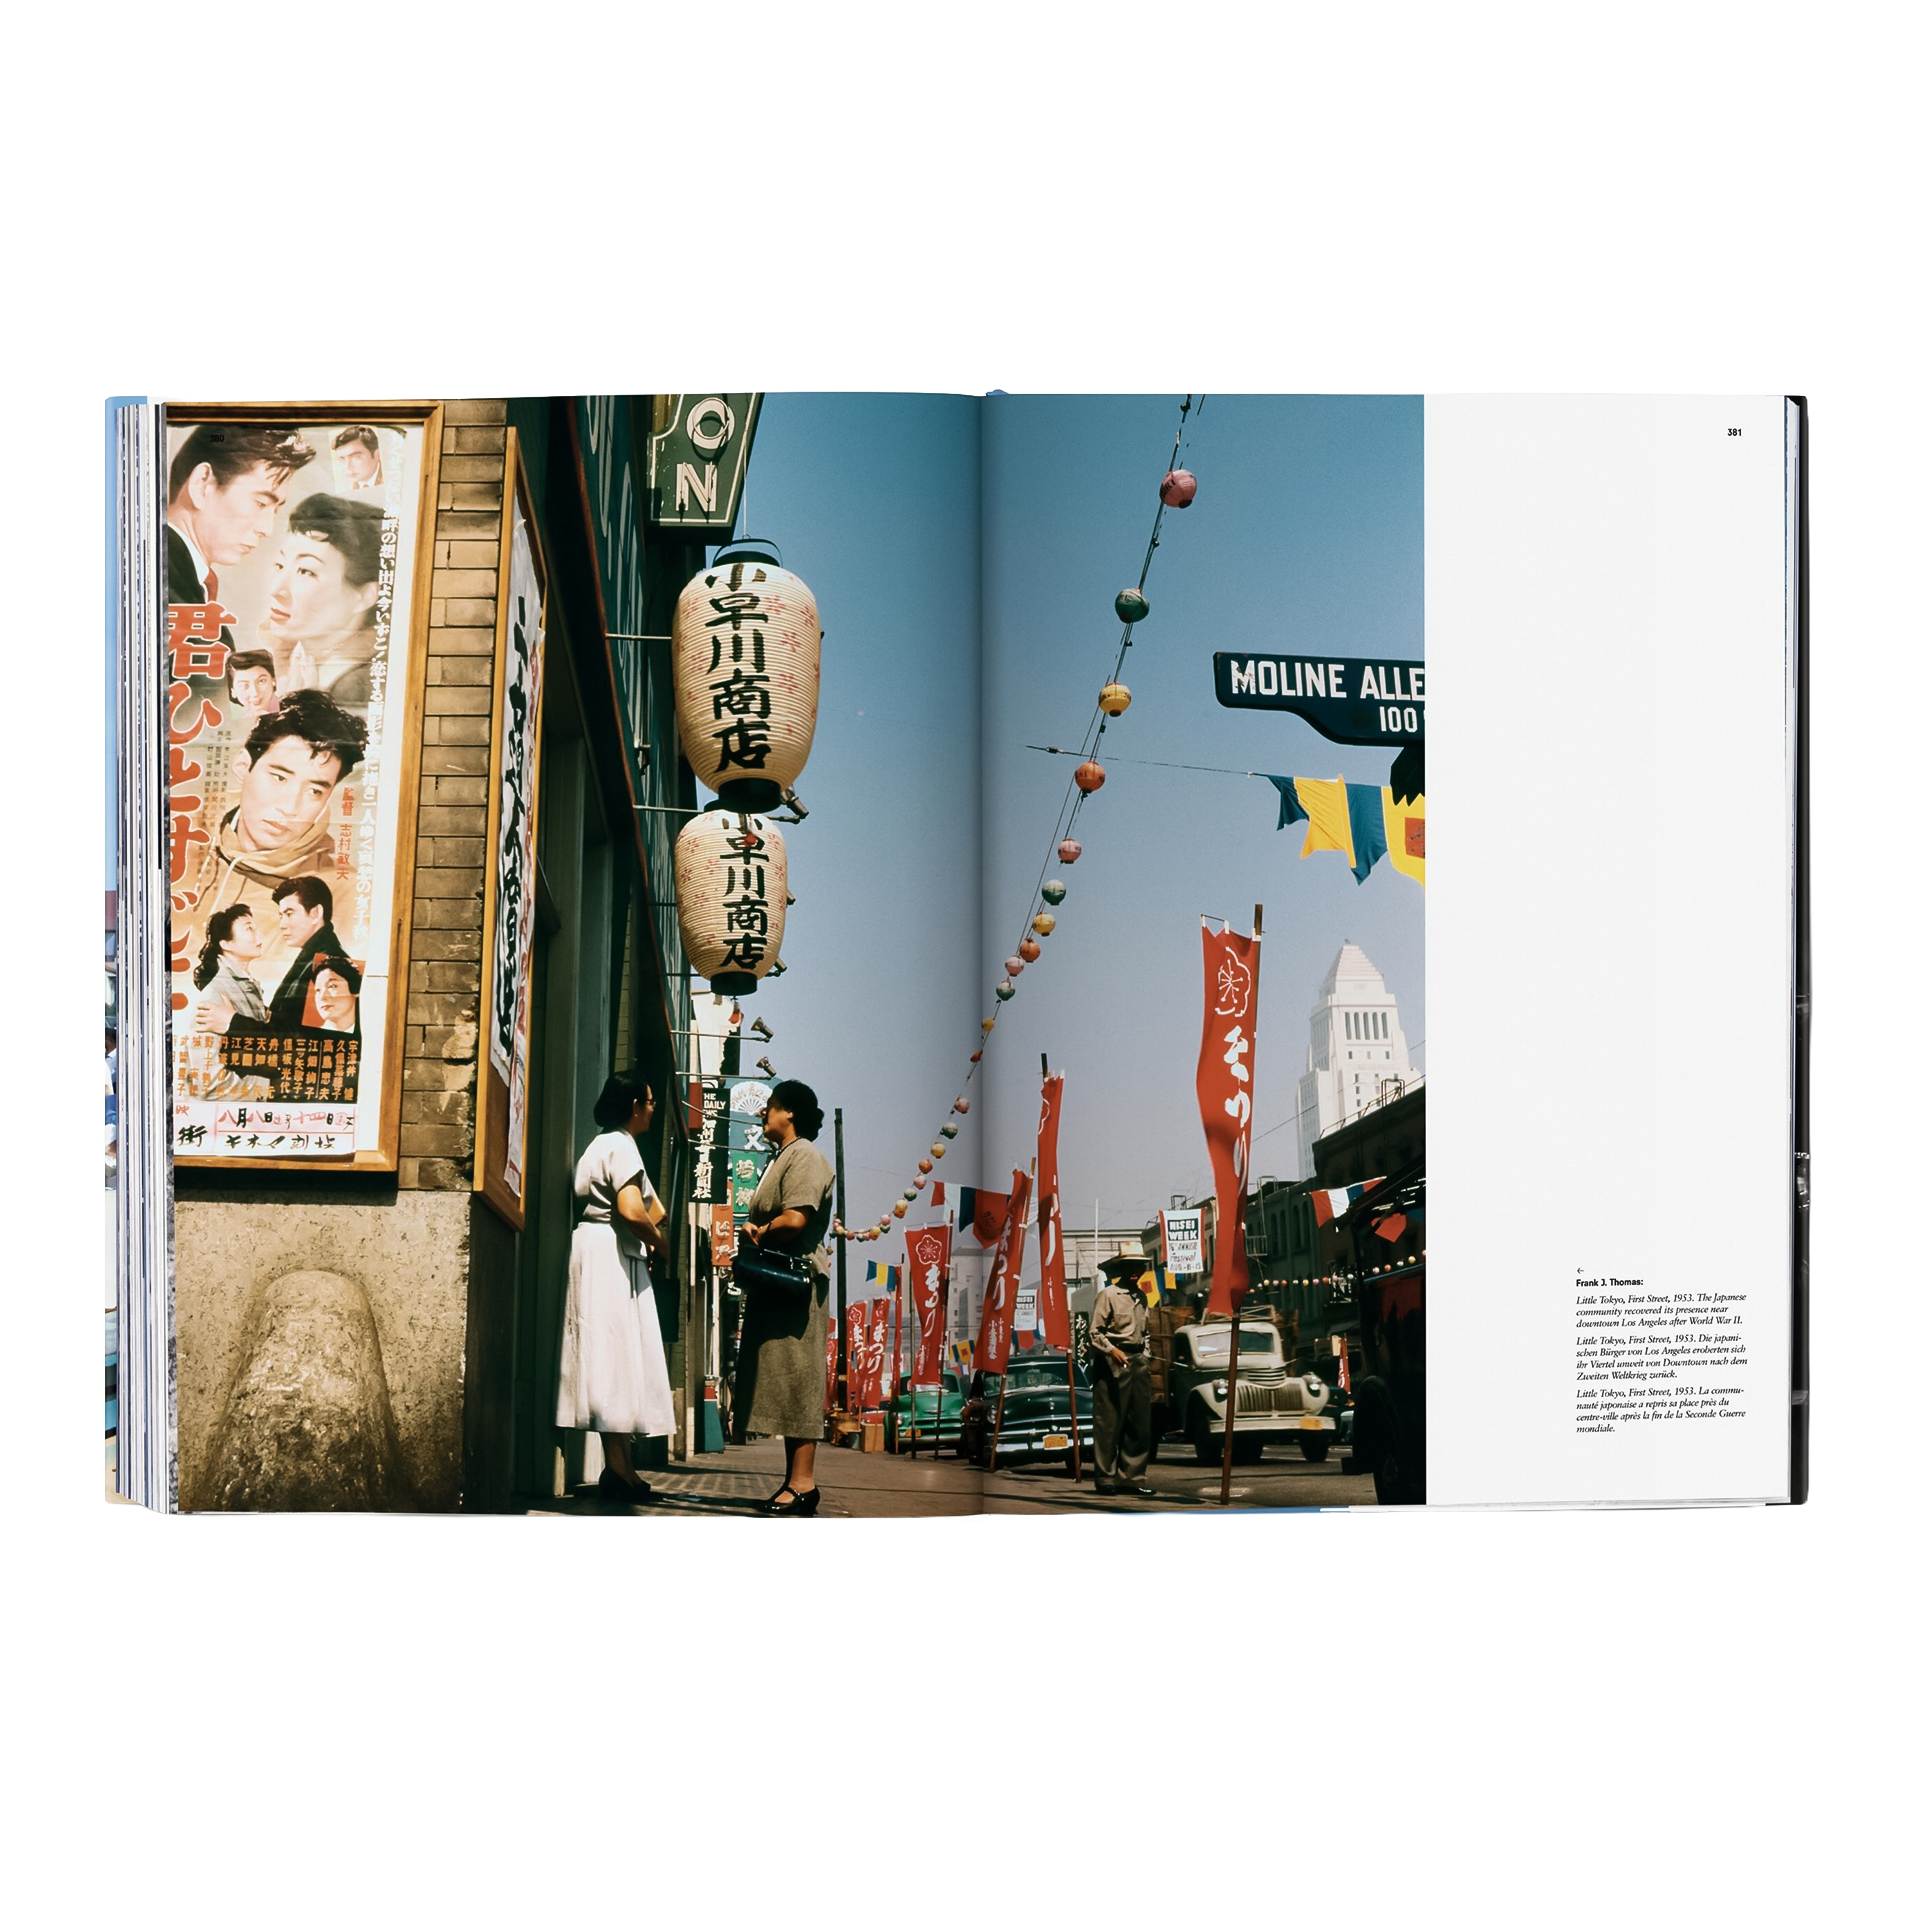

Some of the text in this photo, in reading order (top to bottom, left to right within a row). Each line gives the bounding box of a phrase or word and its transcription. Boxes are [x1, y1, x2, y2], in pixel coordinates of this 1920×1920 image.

[209, 434, 225, 443] 380
[1727, 428, 1742, 437] 381
[704, 563, 773, 774] 小早川商店
[1230, 660, 1426, 702] MOLINE ALLE
[1379, 706, 1418, 733] 100
[719, 813, 770, 970] 小早川商店
[703, 1100, 726, 1110] DAILY
[1169, 1220, 1195, 1230] NISEI
[1169, 1230, 1197, 1240] WEEK
[1576, 1278, 1644, 1287] Frank J. Thomas:
[1576, 1293, 1747, 1306] Little Tokyo, First Street, 1953. The Japanese
[1576, 1307, 1623, 1317] community
[1624, 1305, 1663, 1315] recovered
[1664, 1306, 1674, 1314] its
[1675, 1307, 1709, 1316] presence
[1576, 1316, 1743, 1328] downtown Los Angeles after World War II.
[1576, 1333, 1742, 1347] Little Tokyo, First Street, 1953. Die japani-
[1576, 1348, 1598, 1357] schen
[1600, 1348, 1626, 1358] Bürger
[1645, 1347, 1659, 1355] Los
[1661, 1345, 1691, 1357] Angeles
[1692, 1345, 1729, 1354] eroberten
[1730, 1344, 1746, 1353] sich
[1576, 1360, 1588, 1369] ihr
[1590, 1359, 1616, 1368] Viertel
[1616, 1359, 1644, 1368] unweit
[1663, 1358, 1708, 1367] Downtown
[1710, 1356, 1729, 1365] nach
[1730, 1356, 1748, 1365] dem
[1576, 1369, 1677, 1381] Zweiten Weltkrieg zurück.
[1576, 1389, 1598, 1398] Little
[1600, 1389, 1626, 1399] Tokyo,
[1628, 1388, 1646, 1397] First
[1647, 1388, 1672, 1397] Street,
[1675, 1386, 1696, 1395] 1953.
[1698, 1386, 1709, 1395] La
[1576, 1401, 1599, 1409] nauté
[1599, 1400, 1637, 1411] japonaise
[1645, 1399, 1667, 1410] repris
[1679, 1398, 1699, 1409] place
[1700, 1398, 1717, 1409] près
[1718, 1397, 1730, 1406] du
[1576, 1409, 1746, 1422] centre-ville après la fin de la Seconde Guerre
[1576, 1423, 1615, 1433] mondiale.
